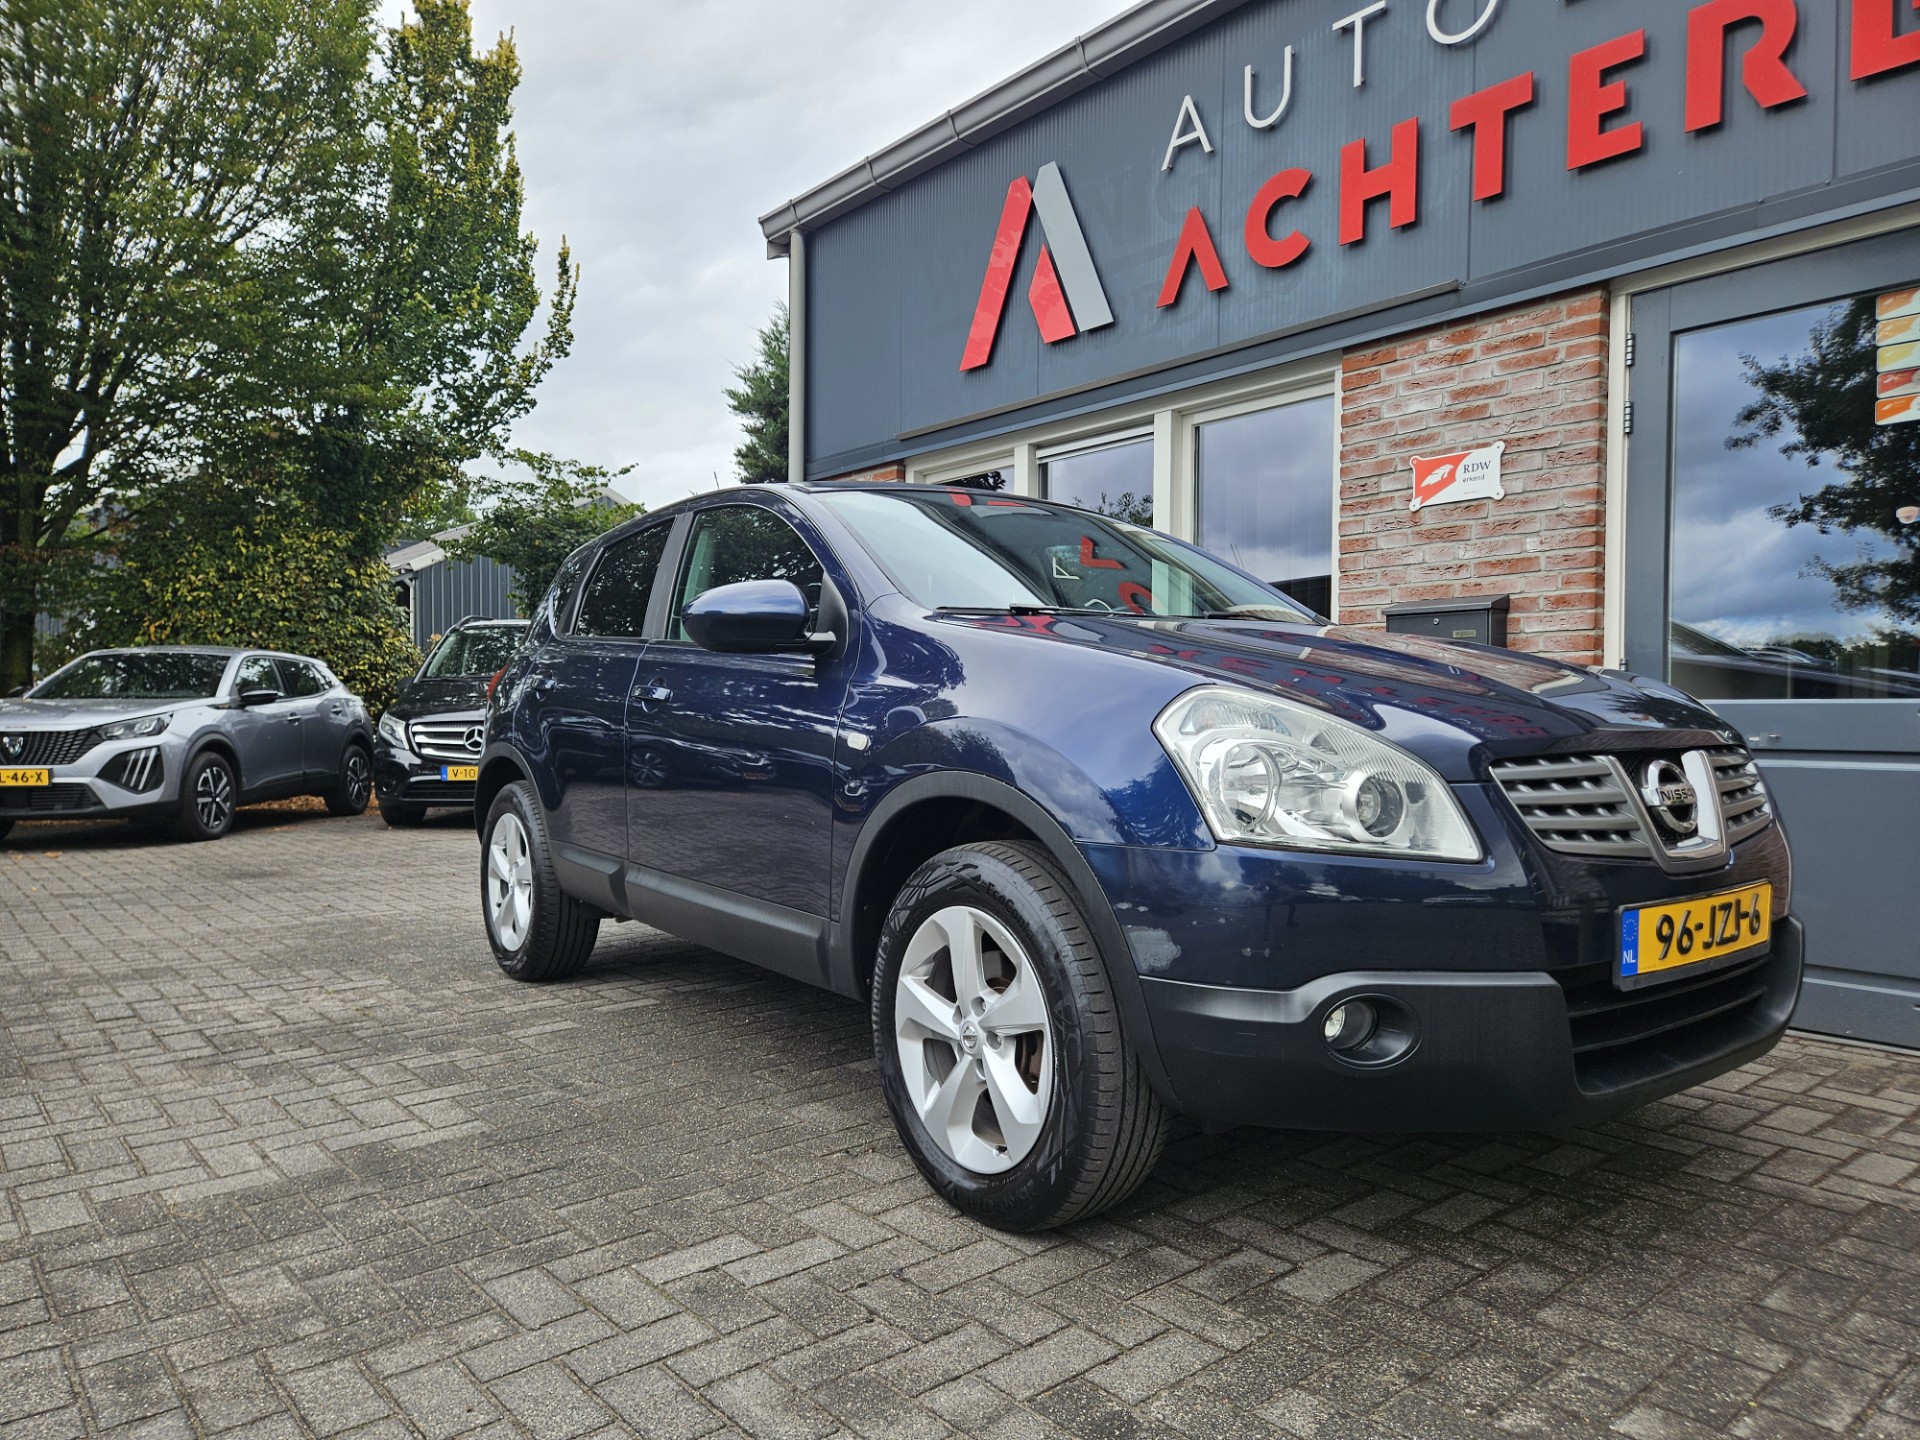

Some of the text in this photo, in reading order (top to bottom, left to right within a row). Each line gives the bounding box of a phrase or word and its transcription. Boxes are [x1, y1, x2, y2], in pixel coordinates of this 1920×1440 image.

[1463, 460, 1491, 474] RDW
[1462, 474, 1485, 483] erkend
[452, 768, 476, 779] V-10
[1660, 788, 1695, 801] NISSA
[1623, 893, 1760, 964] NL 96-JZJ-6
